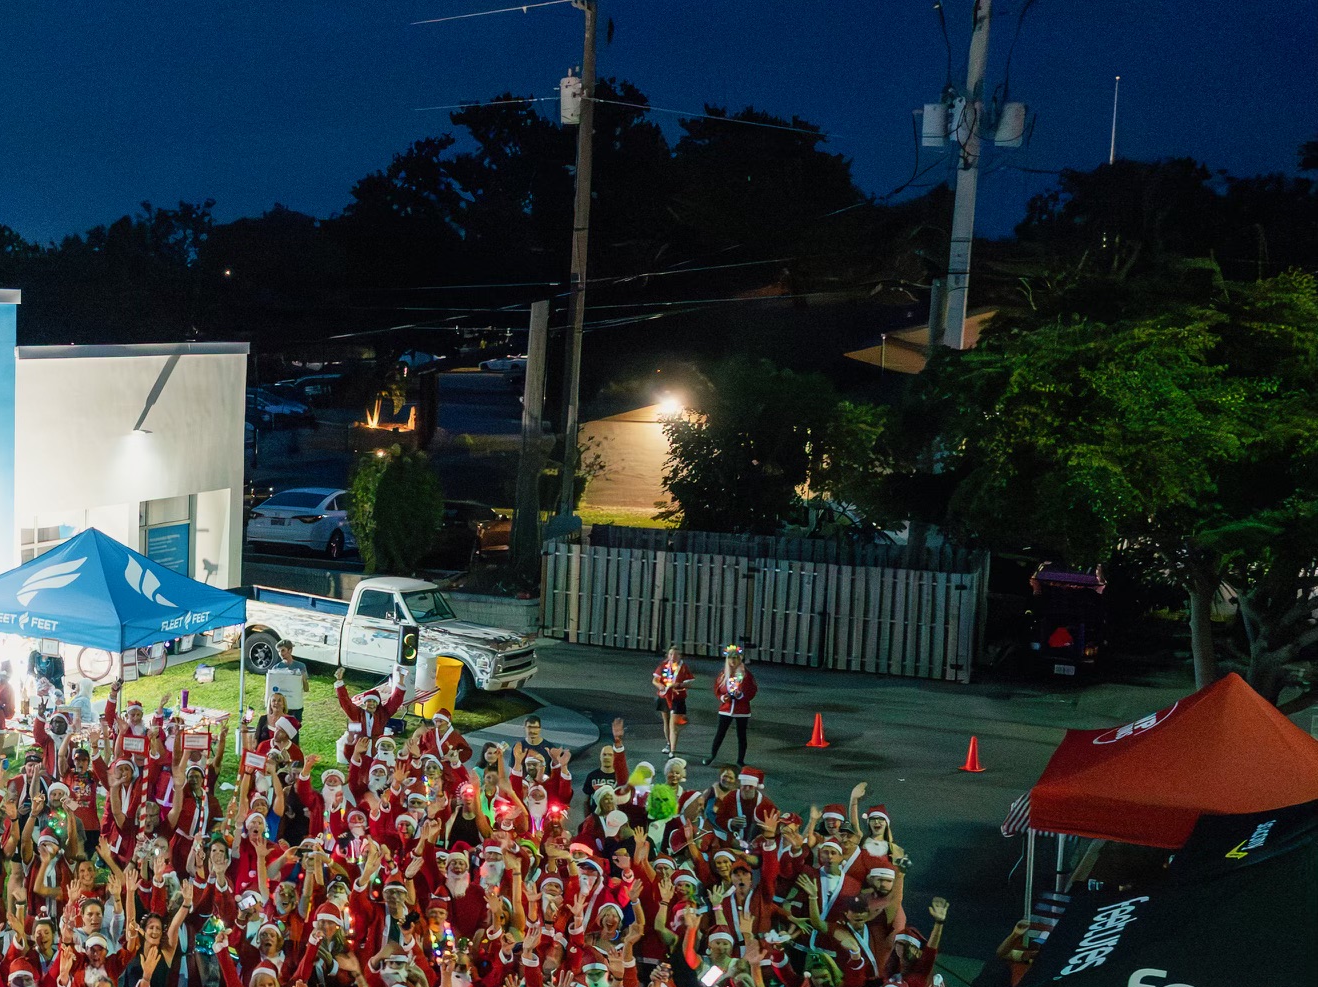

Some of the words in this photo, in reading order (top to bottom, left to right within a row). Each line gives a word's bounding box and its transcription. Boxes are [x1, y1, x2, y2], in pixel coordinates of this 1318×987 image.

[30, 617, 59, 631] FEET
[161, 616, 184, 632] FLEET
[192, 611, 211, 625] FEET
[1060, 895, 1150, 976] feetures
